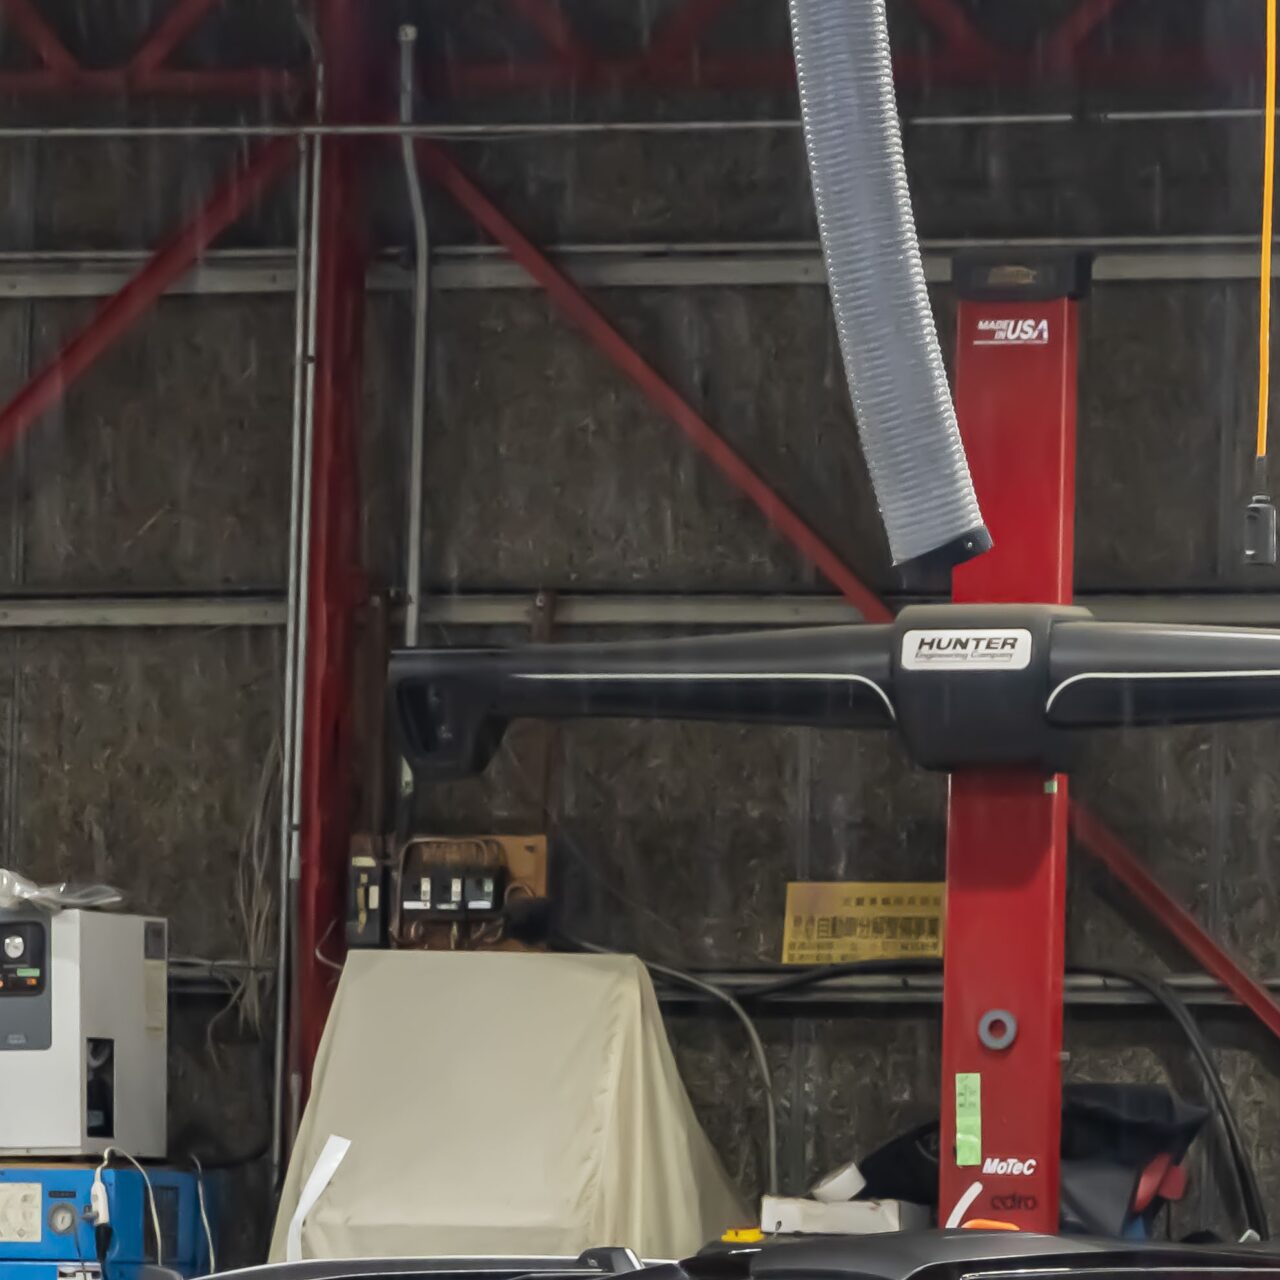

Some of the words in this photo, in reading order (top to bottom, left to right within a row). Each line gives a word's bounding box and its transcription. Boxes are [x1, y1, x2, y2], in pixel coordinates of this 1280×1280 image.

[1006, 319, 1049, 341] USA
[918, 636, 1018, 651] HUNTER
[982, 1157, 1036, 1175] MoTeC
